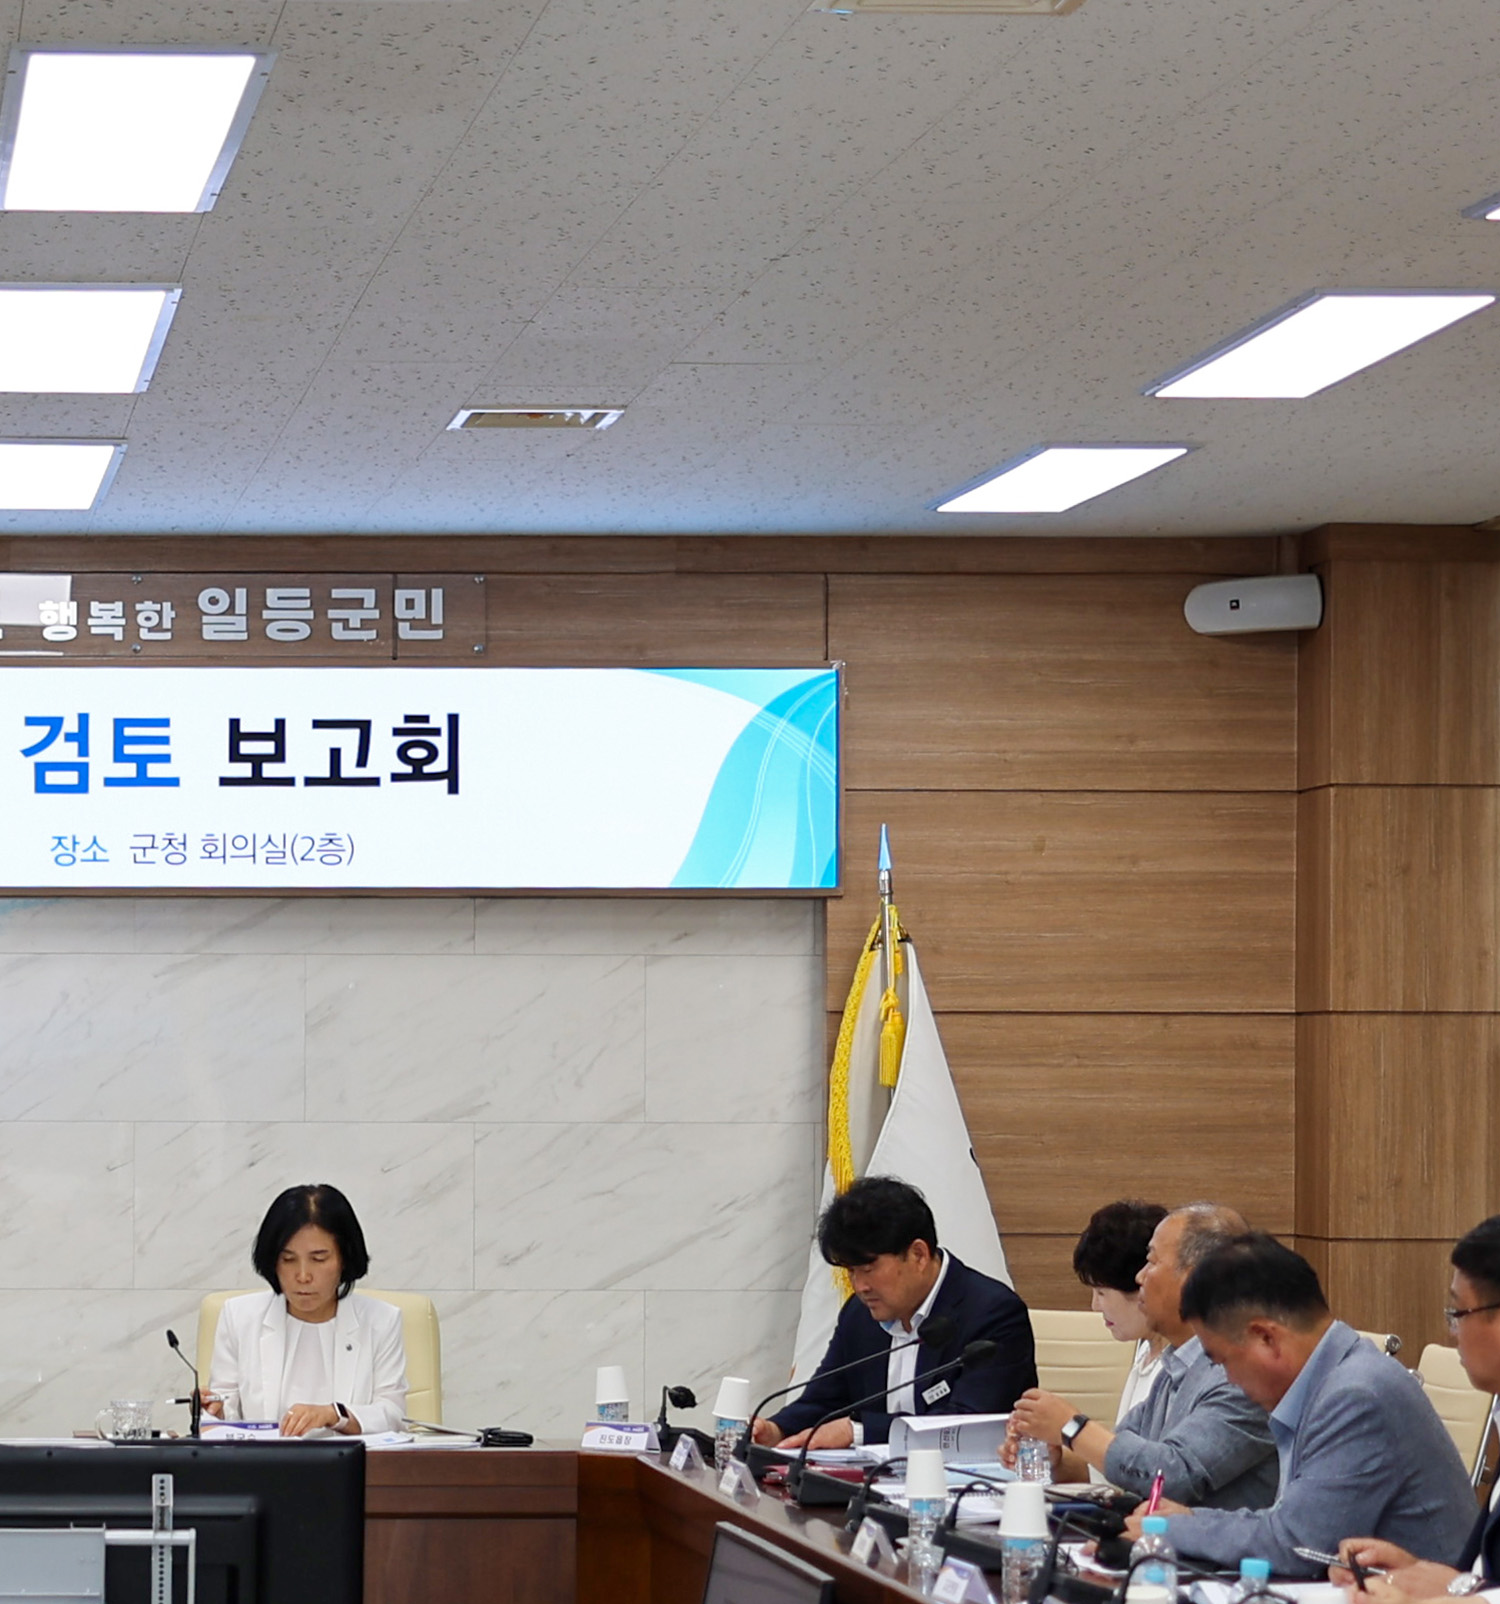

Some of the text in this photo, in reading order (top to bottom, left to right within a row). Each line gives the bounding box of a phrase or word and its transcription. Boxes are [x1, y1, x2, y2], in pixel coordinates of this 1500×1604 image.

[39, 600, 176, 641] 행복한
[198, 588, 443, 640] 일등군민
[20, 712, 180, 794] 검토
[218, 713, 460, 795] 보고회
[51, 835, 110, 867] 장소
[130, 833, 187, 865] 군청
[200, 833, 354, 865] 회의실(2층)
[600, 1433, 632, 1445] 진도읍장
